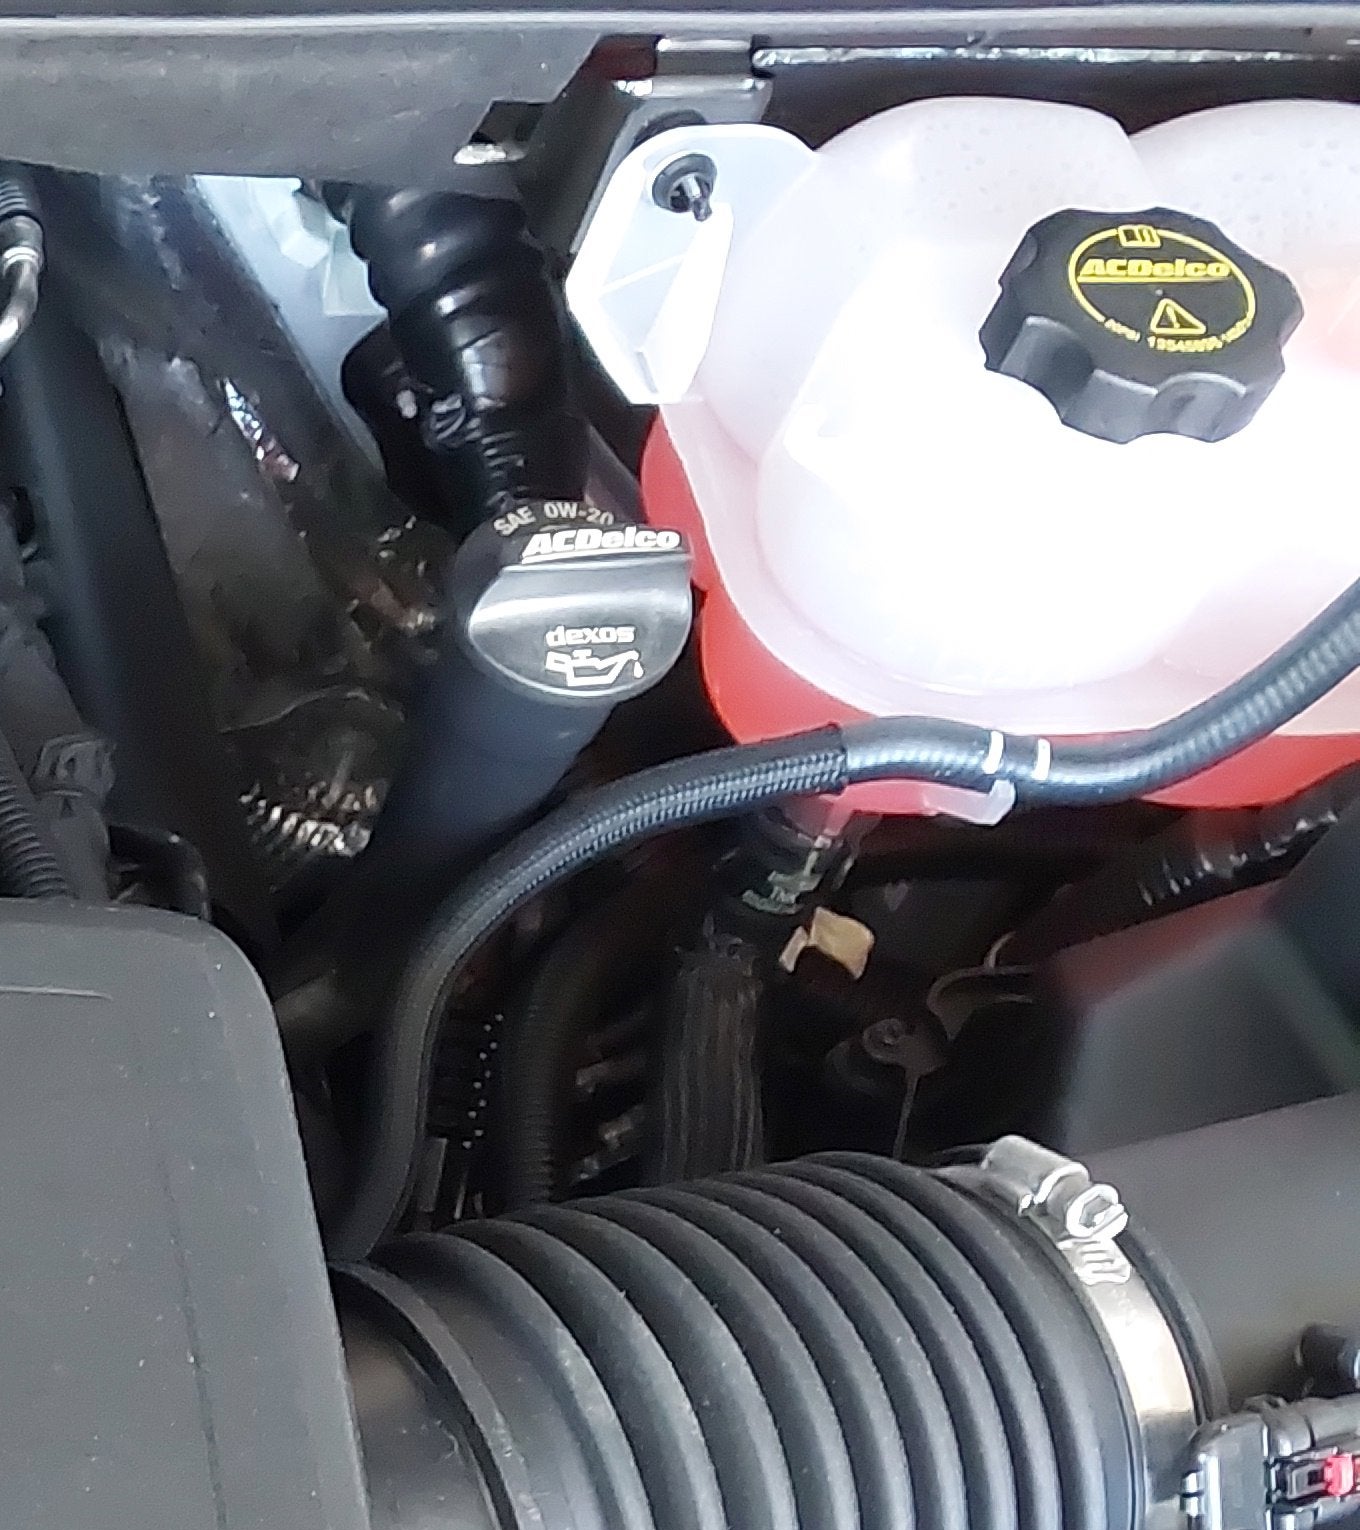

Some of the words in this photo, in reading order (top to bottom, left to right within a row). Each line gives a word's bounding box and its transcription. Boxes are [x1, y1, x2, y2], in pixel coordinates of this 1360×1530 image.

[1078, 257, 1232, 278] ACDelco
[493, 505, 536, 536] SAE
[521, 525, 682, 559] ACDelco
[545, 624, 637, 648] dexos
